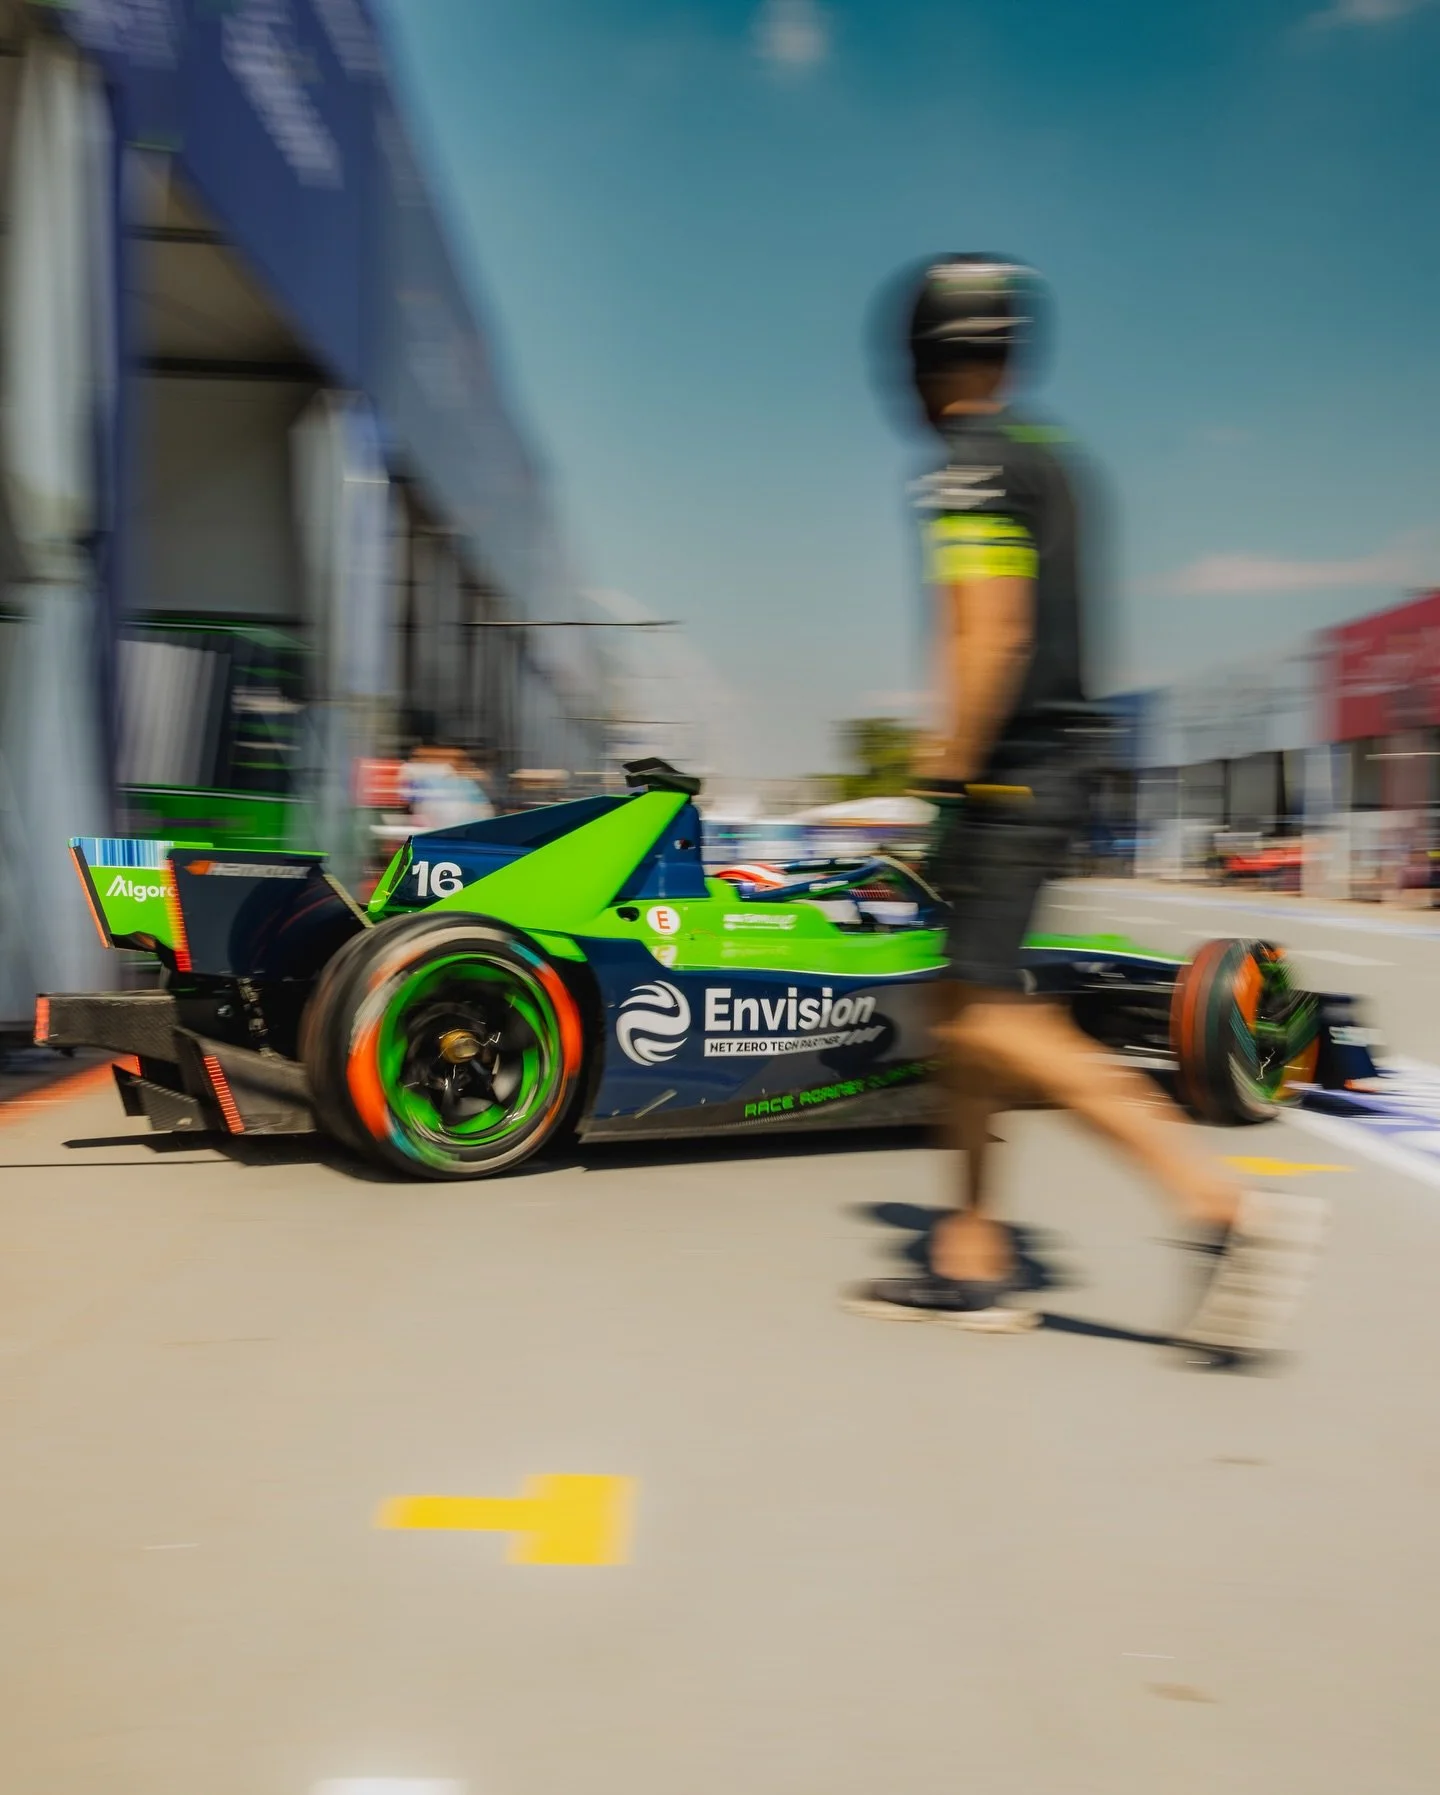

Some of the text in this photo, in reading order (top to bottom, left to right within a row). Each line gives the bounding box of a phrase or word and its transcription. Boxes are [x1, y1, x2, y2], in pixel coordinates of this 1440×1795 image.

[412, 861, 464, 898] 16
[656, 911, 671, 930] E
[704, 987, 876, 1032] Envision
[709, 1042, 733, 1053] NET
[736, 1041, 768, 1052] ZERO
[770, 1040, 798, 1051] TECH
[745, 1094, 794, 1118] RACE
